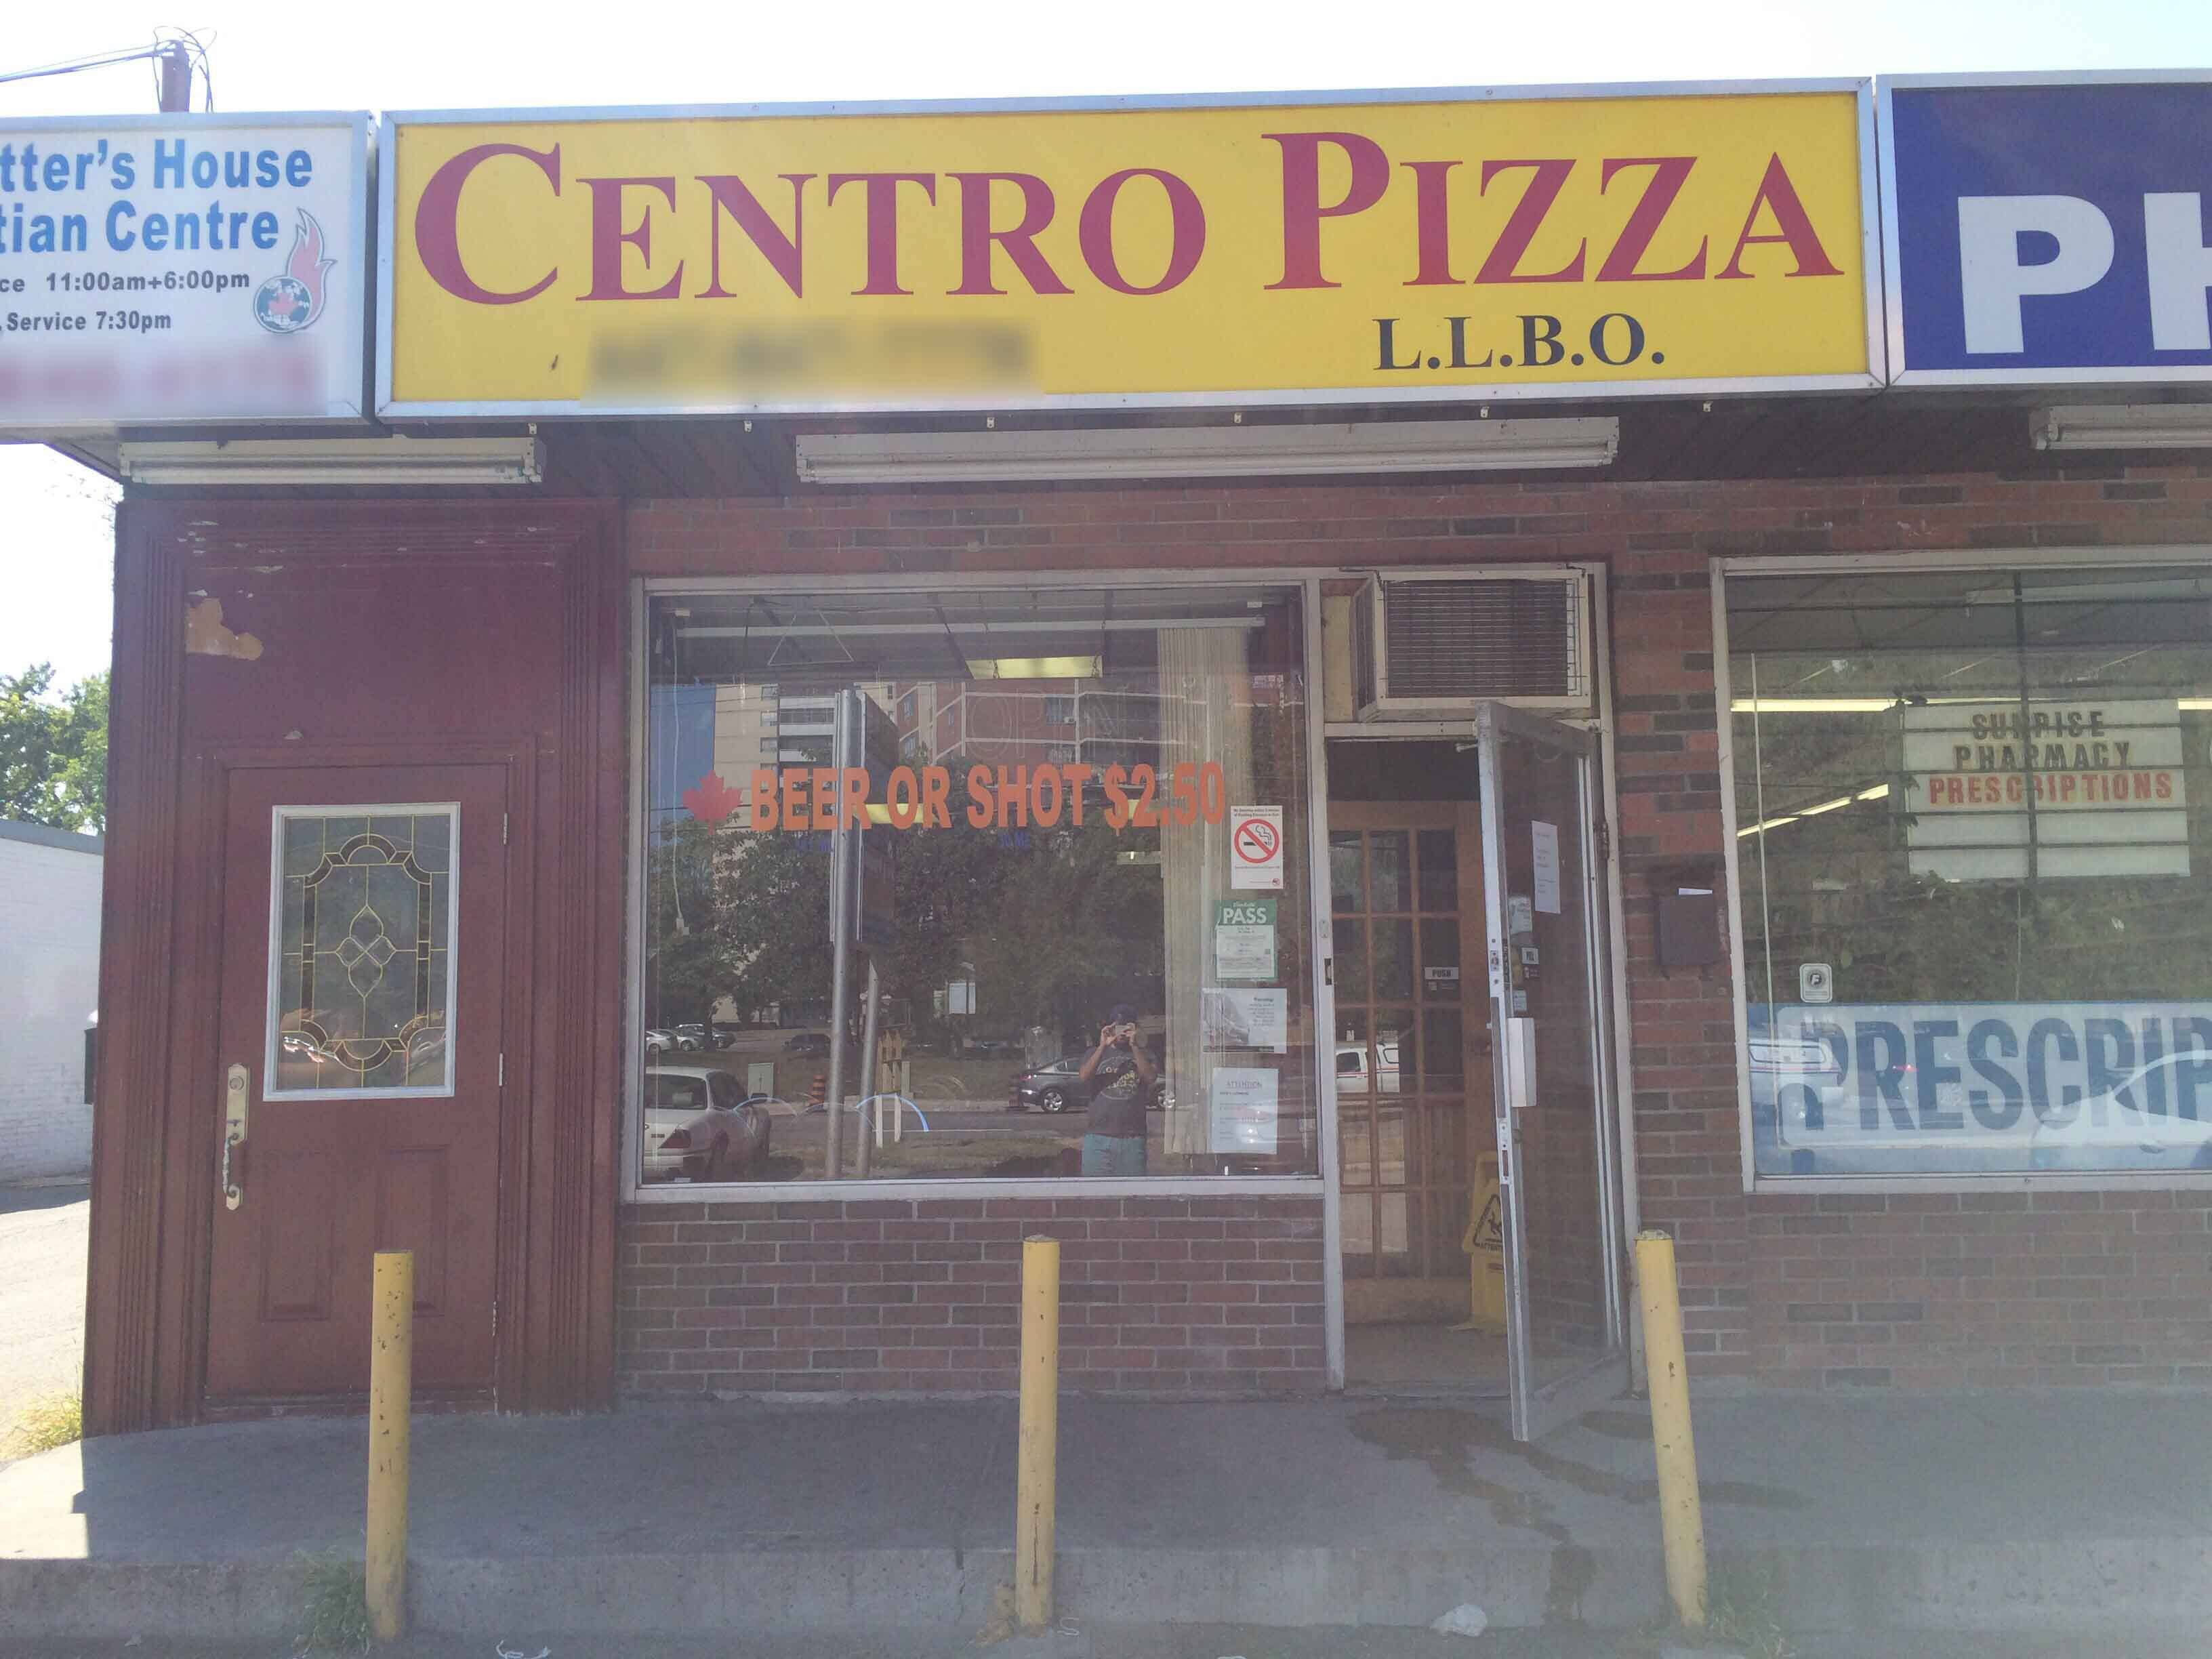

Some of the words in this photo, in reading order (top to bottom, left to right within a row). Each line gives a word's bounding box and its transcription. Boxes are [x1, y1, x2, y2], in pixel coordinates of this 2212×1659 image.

[154, 138, 313, 189] House
[105, 200, 279, 251] Centre
[414, 142, 1206, 305] CENTRO
[1261, 131, 1845, 290] PIZZA
[46, 270, 250, 292] 11:00am+6:00pm
[7, 312, 87, 331] Service
[96, 310, 172, 333] 7:30pm
[1372, 312, 1665, 371] L.L.B.O.
[1953, 741, 2130, 771] PHARMACY
[750, 767, 873, 831] BEER
[886, 766, 952, 829] OR
[967, 763, 1092, 829] SHOT
[1104, 761, 1225, 836] $2.50
[1929, 772, 2172, 804] PRESCRIPTIONS
[1223, 907, 1267, 924] PASS
